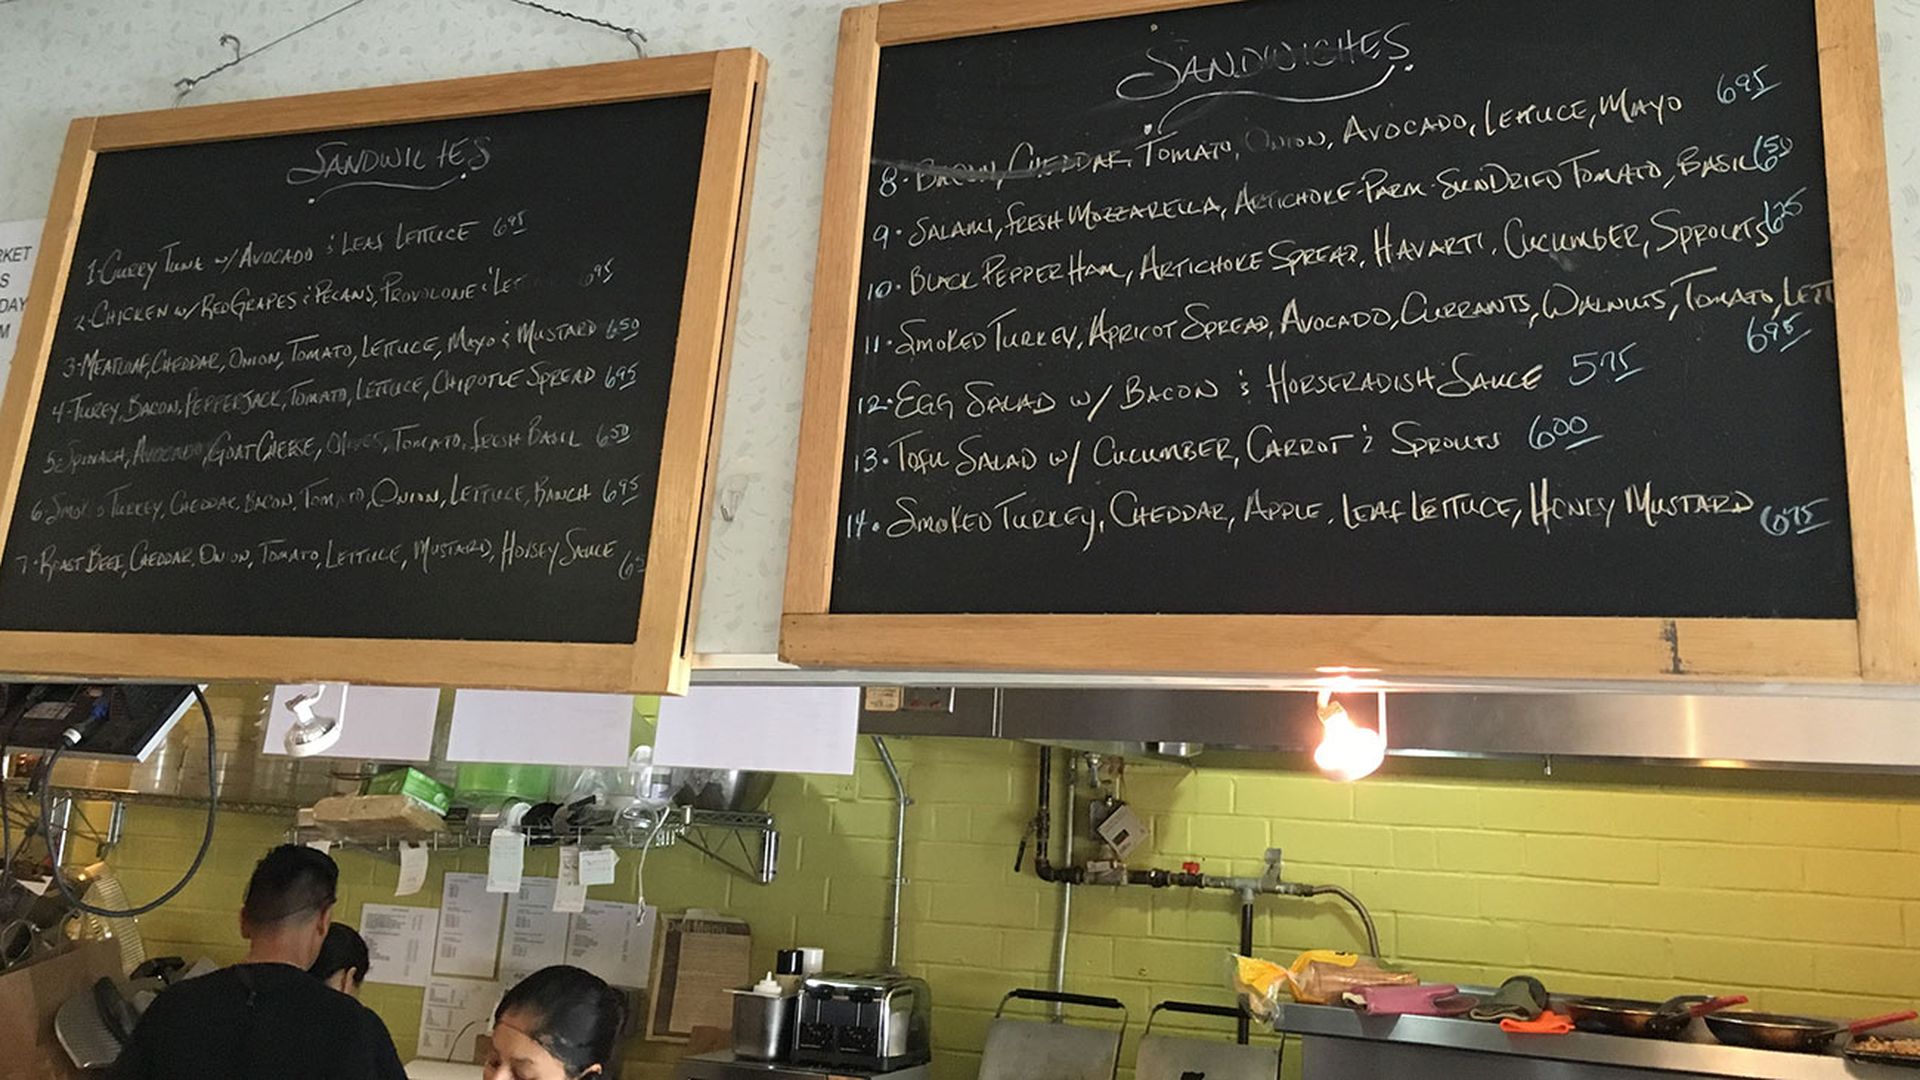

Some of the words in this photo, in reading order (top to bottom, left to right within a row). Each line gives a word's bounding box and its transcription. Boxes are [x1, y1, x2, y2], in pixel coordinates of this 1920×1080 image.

[1135, 130, 1240, 168] TOMATO,
[1343, 115, 1476, 144] AVOCADO,
[1484, 98, 1596, 137] LETTUCE,
[1599, 87, 1682, 126] MAYO
[908, 215, 1002, 246] SALAMI,
[1005, 201, 1063, 237] FRESH
[1067, 198, 1229, 232] MOZZARELLA,
[1559, 149, 1678, 190] TOMATO,
[1677, 144, 1757, 182] BASIL
[239, 240, 313, 269] AVOCADO
[342, 230, 383, 255] LEAF
[396, 221, 480, 249] LETTUCE
[910, 265, 979, 297] BLACK
[982, 253, 1063, 287] PEPPER
[1069, 249, 1134, 287] HAM,
[1138, 245, 1264, 281] ARTICHOKE
[1266, 239, 1365, 277] SPREAD,
[1373, 221, 1497, 268] HAVARTI,
[1504, 217, 1650, 261] CUCUMBER,
[1652, 208, 1769, 251] SPROUTS
[91, 299, 169, 328] CHICKEN
[314, 279, 379, 307] PECANS,
[381, 271, 478, 304] PROVOLONE
[895, 319, 988, 357] SMOKED
[986, 307, 1084, 353] TURKEY,
[1087, 307, 1180, 352] APRICOT
[1180, 302, 1275, 341] SPREAD,
[1280, 299, 1401, 334] AVOCADO,
[1400, 290, 1539, 330] CURRANTS,
[1541, 282, 1679, 321] WALNUTS,
[1669, 265, 1783, 320] TOMATO,
[151, 348, 226, 375] CHEDDAR,
[229, 346, 284, 371] ONION,
[286, 334, 358, 368] TOMATO,
[362, 334, 442, 361] LETTUCE,
[447, 325, 496, 356] MAYO
[516, 319, 598, 355] MUSTARD
[123, 394, 183, 423] BACON,
[288, 379, 352, 408] TOMATO,
[356, 377, 430, 402] LETTUCE,
[432, 368, 525, 396] CHIPOTLE
[526, 360, 597, 396] SPREAD
[894, 380, 955, 421] EGG
[963, 381, 1057, 418] SALAD
[1119, 374, 1220, 411] BACON
[1264, 360, 1436, 404] HORSERADISH
[1434, 352, 1545, 398] SAUCE
[207, 430, 258, 466] GOAT
[256, 430, 322, 462] CHEESE,
[528, 415, 582, 446] BASIL
[887, 430, 950, 475] TOFU
[954, 434, 1038, 476] SALAD
[1092, 434, 1240, 470] CUCUMBER,
[1246, 423, 1355, 464] CARROT
[1390, 420, 1502, 459] SPROUTS
[170, 489, 241, 519] CHEDDAR,
[371, 476, 446, 511] ONION,
[449, 472, 531, 508] LETTUCE,
[886, 496, 994, 539] SMOKED
[992, 491, 1105, 552] TURKEY,
[1110, 490, 1237, 533] CHEDDAR,
[1243, 488, 1335, 525] APPLE,
[1341, 490, 1409, 530] LEAF
[1409, 490, 1524, 530] LETTUCE,
[1528, 477, 1619, 535] HONEY
[1622, 480, 1757, 528] MUSTARD
[129, 539, 196, 573] CHEDDAR,
[258, 538, 322, 571] TOMATO,
[325, 539, 408, 572] LETTUCE,
[413, 536, 497, 576] MUSTARD,
[558, 528, 620, 567] SAUCE
